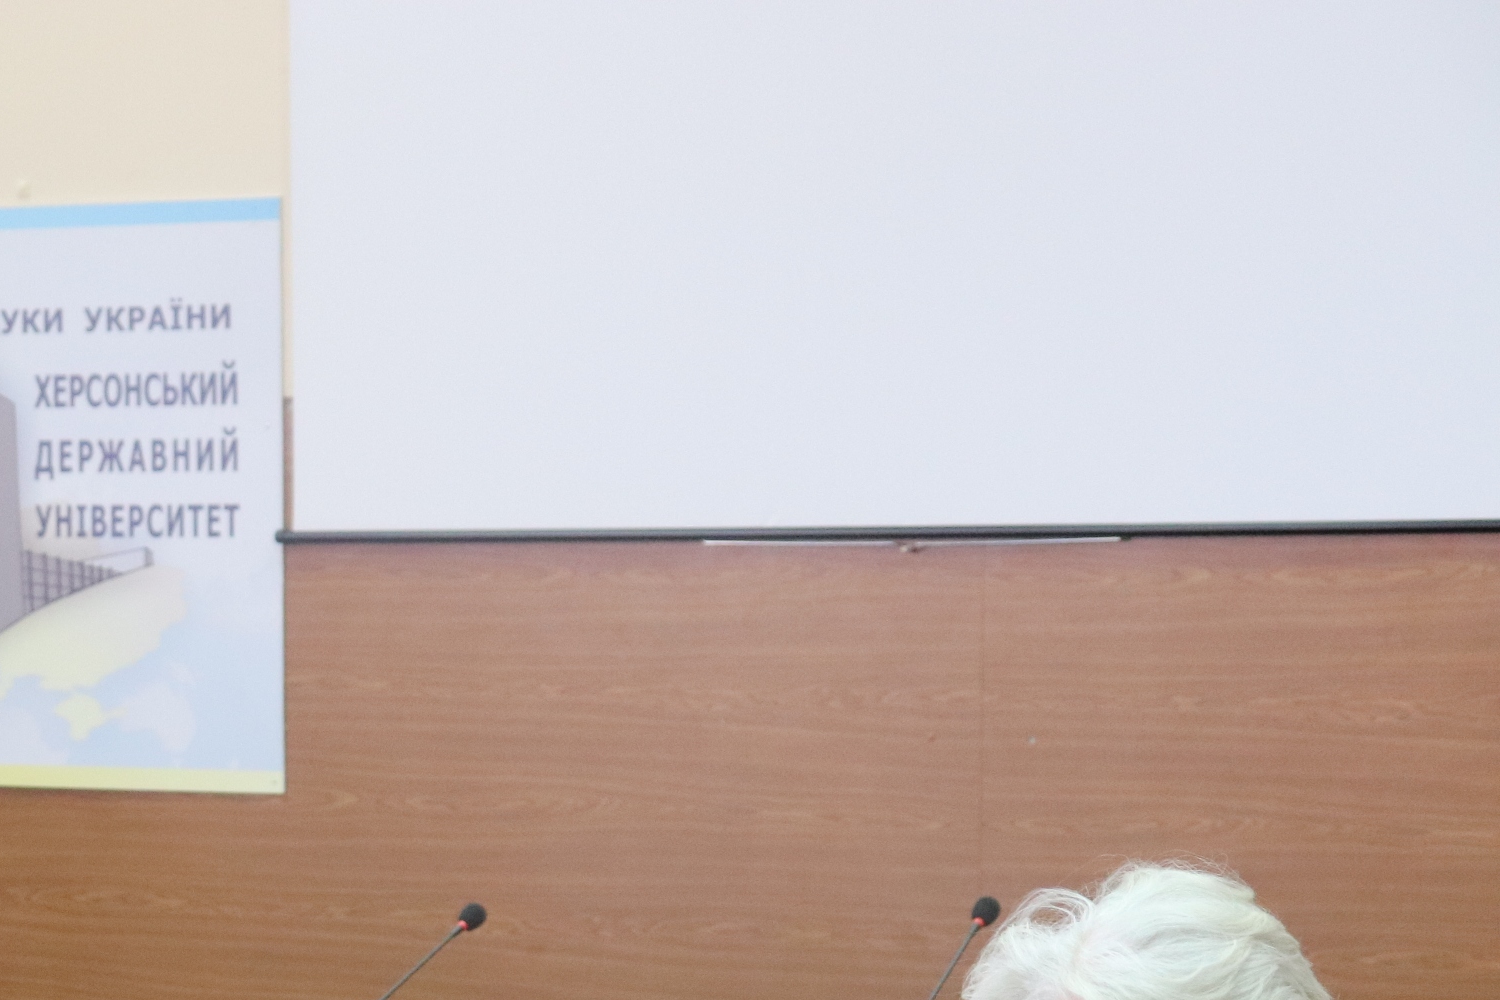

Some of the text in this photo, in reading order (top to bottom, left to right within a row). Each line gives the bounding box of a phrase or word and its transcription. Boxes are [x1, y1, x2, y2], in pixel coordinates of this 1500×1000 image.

[84, 296, 231, 332] УКРАЇНИ
[34, 360, 239, 408] ХЕРСОНСЬКИЙ
[34, 426, 239, 480] ДЕРЖАВНИЙ
[34, 504, 240, 539] УНІВЕРСИТЕТ
